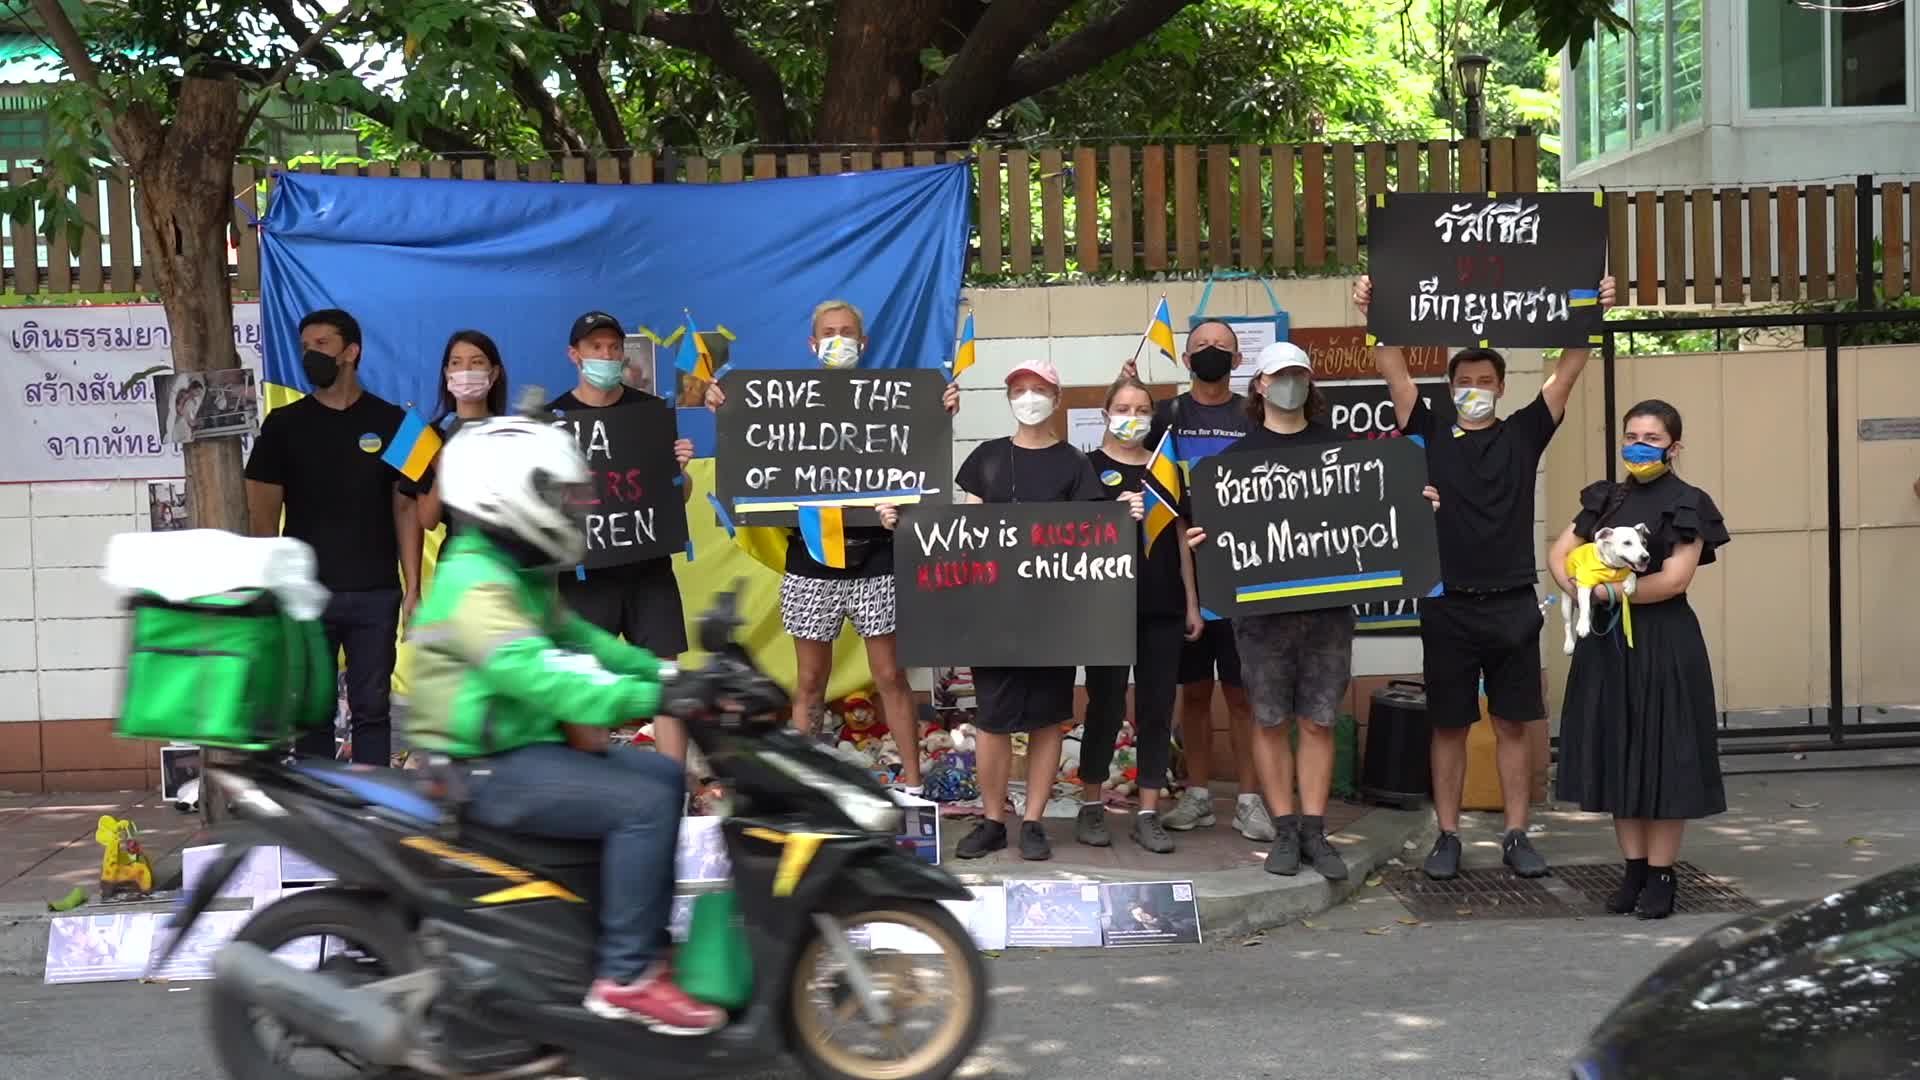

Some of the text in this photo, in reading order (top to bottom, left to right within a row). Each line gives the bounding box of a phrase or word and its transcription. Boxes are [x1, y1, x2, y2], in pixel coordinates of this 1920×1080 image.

[26, 372, 155, 403] สร้างสันต
[745, 379, 912, 411] SAVE THE
[746, 422, 910, 455] CHILDREN
[1198, 428, 1211, 436] for
[1212, 428, 1247, 438] Ukraine
[745, 465, 940, 494] OF MARIUPOL
[914, 515, 989, 556] Why
[1000, 520, 1018, 547] is
[1217, 505, 1399, 571] ใน Mariupol
